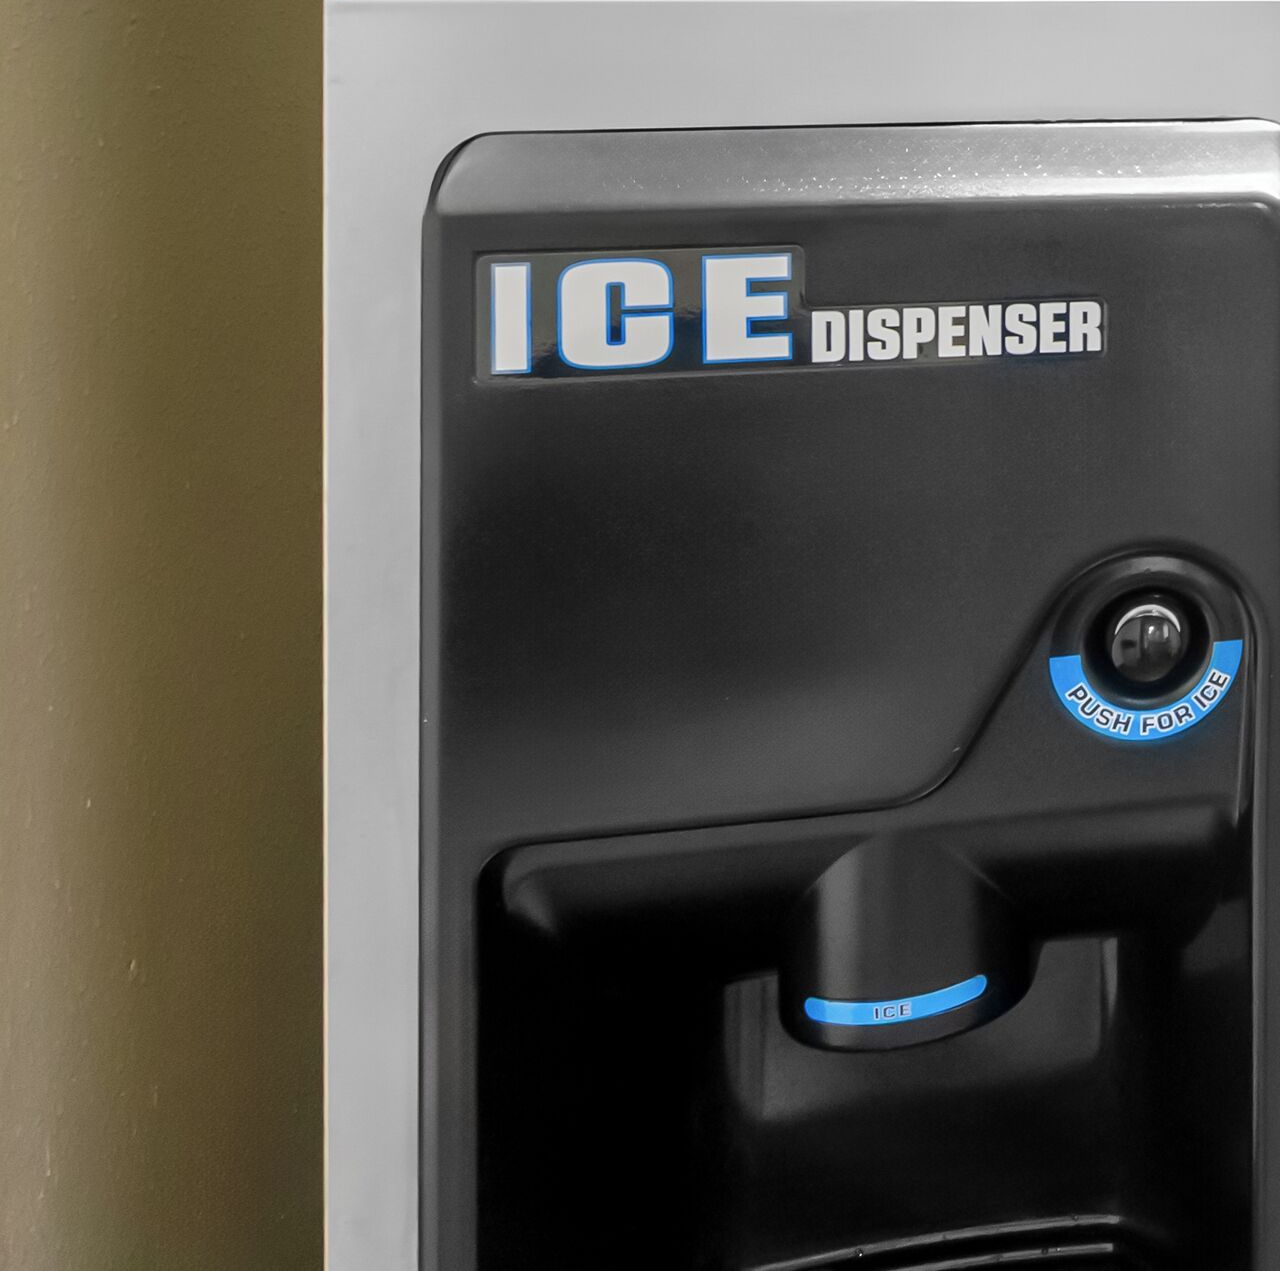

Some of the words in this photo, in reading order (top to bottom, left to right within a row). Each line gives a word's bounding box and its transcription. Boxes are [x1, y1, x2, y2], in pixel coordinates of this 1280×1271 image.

[491, 252, 793, 374] ICE
[811, 301, 1102, 363] DISPENSER
[1067, 684, 1132, 733] PUSH
[1142, 704, 1193, 734] FOR
[1194, 671, 1229, 708] ICE
[874, 1003, 911, 1020] ICE
